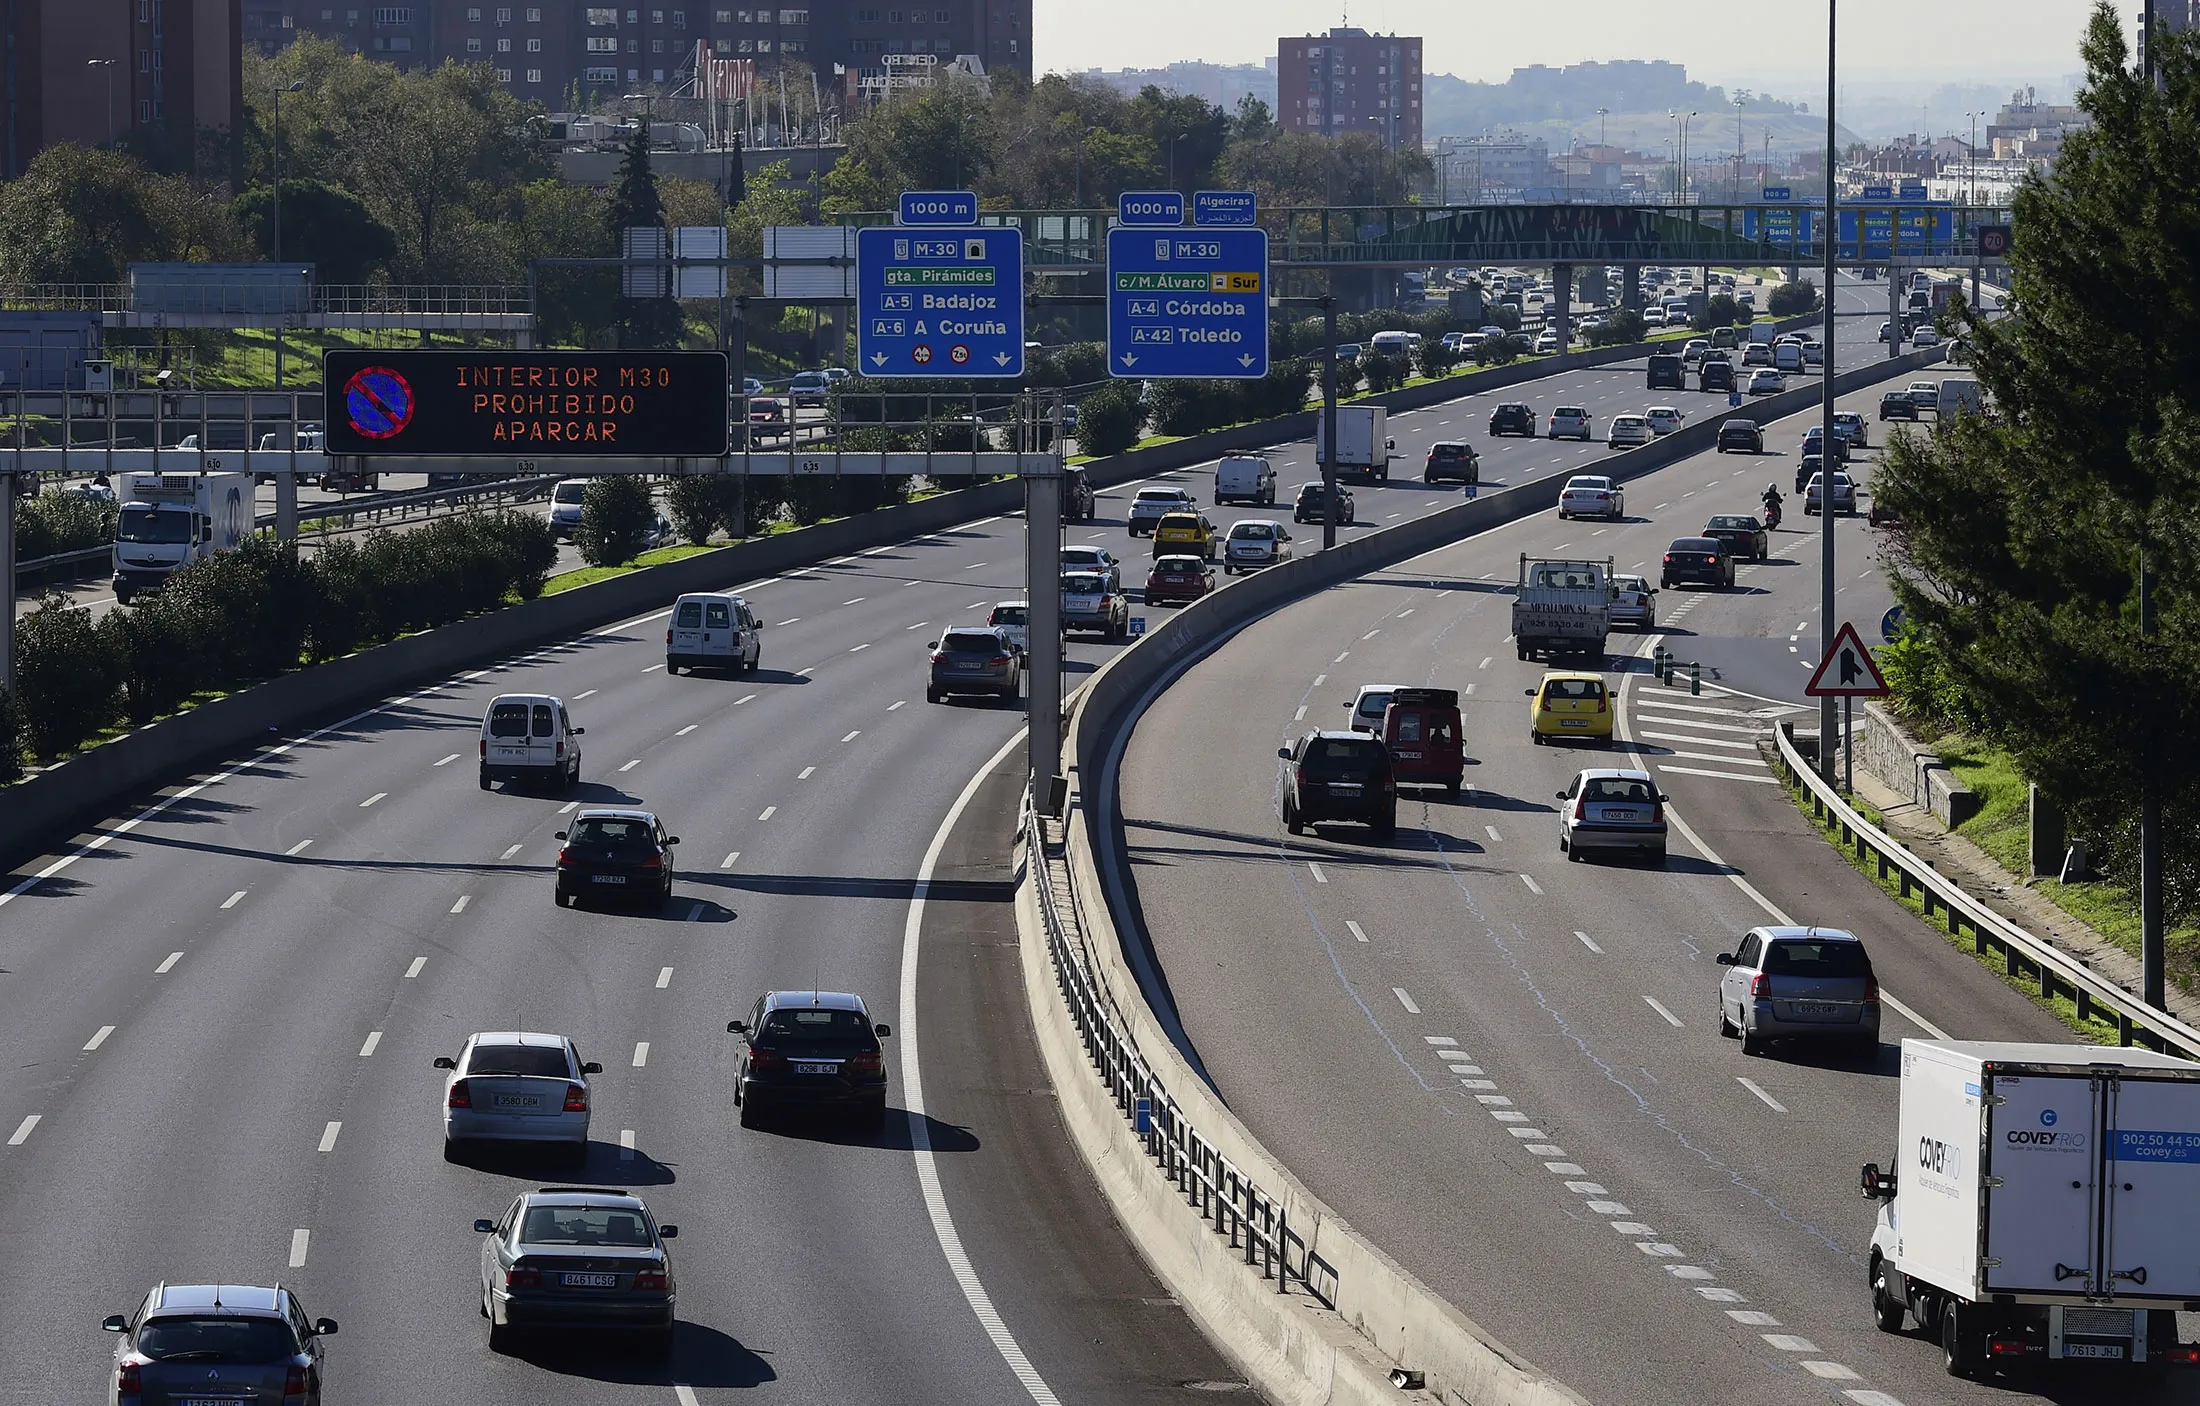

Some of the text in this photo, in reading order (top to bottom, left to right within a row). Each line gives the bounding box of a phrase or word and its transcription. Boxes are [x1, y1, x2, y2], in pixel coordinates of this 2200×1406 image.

[1200, 197, 1250, 207] Algeciras
[910, 203, 967, 214] 1000 m
[1126, 203, 1178, 214] 1000 m
[1988, 236, 2001, 246] 70
[916, 244, 955, 255] M-30
[1178, 244, 1218, 256] M-30
[887, 270, 992, 284] gta. Pirámides
[1233, 277, 1257, 288] Sur
[884, 293, 996, 311] A-5 Badajoz
[1131, 300, 1245, 315] A-4 Córdoba
[876, 320, 1007, 335] A-6 A Coruña
[1134, 328, 1242, 343] A-42 Toledo
[457, 367, 669, 386] INTERIOR M30
[474, 394, 634, 414] PROHIBIDO
[493, 421, 616, 441] APARCAR
[1530, 619, 1546, 628] 926
[500, 1096, 521, 1105] 3580
[2123, 1134, 2200, 1147] 902 50 44 50
[2136, 1147, 2187, 1158] covey.es
[567, 1275, 616, 1287] 8461 CSG
[2072, 1345, 2119, 1357] 7613 JHJ
